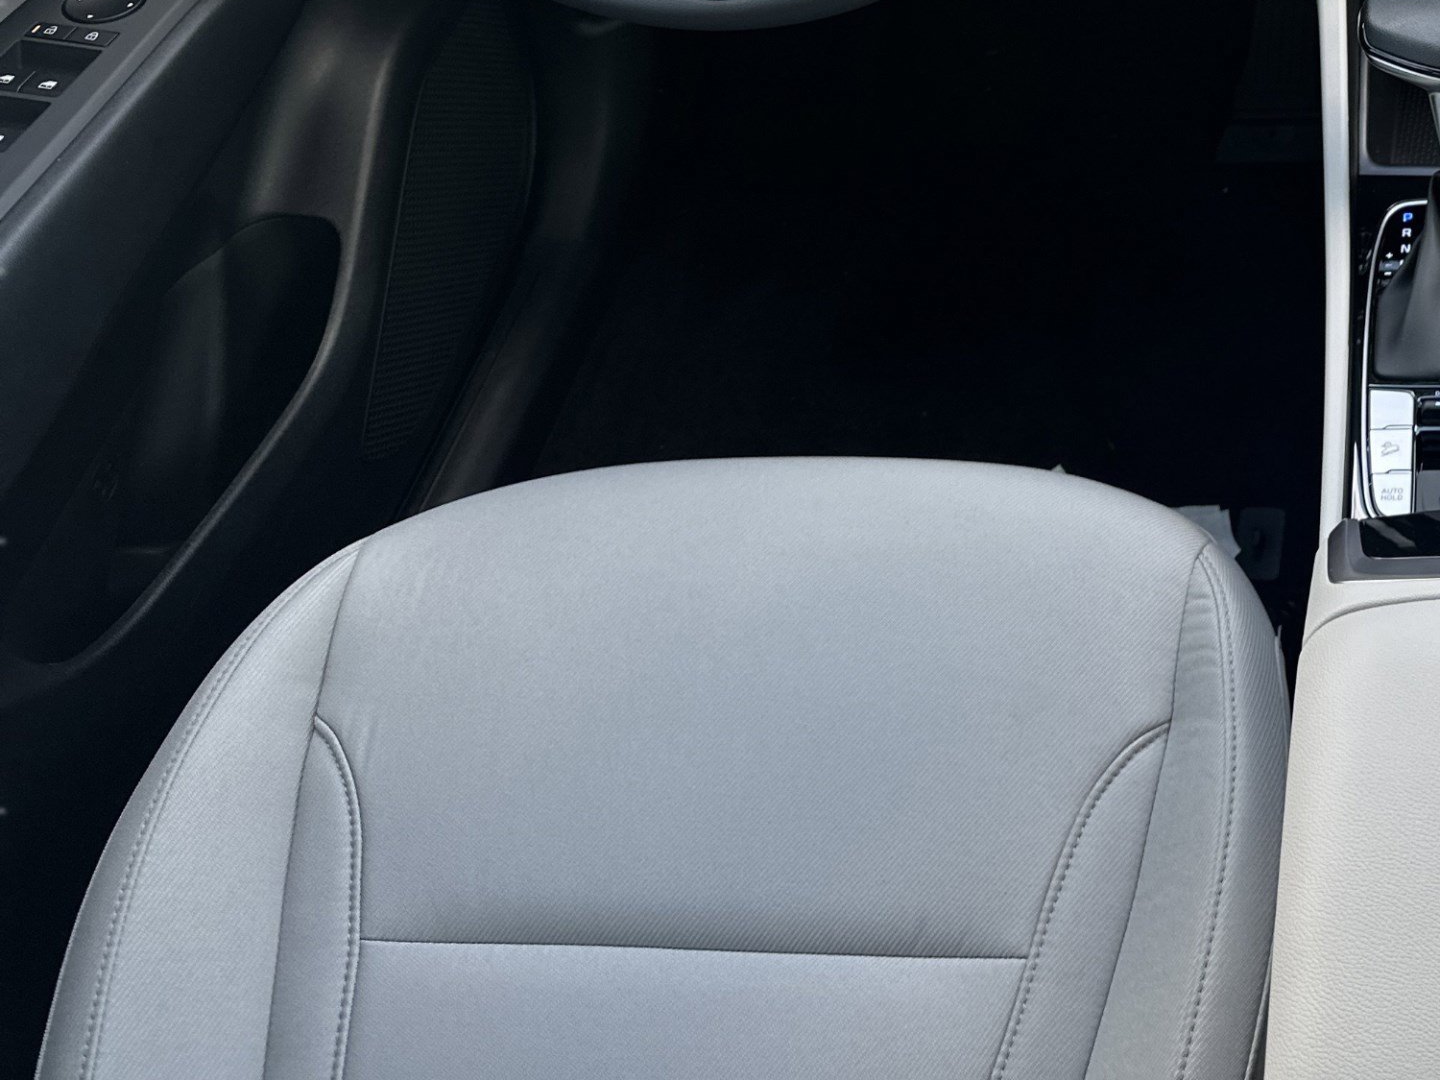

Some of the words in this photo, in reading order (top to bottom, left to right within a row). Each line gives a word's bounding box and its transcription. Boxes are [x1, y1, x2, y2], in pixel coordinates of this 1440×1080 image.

[1403, 213, 1413, 222] P
[1402, 228, 1411, 238] R
[1401, 244, 1411, 254] N
